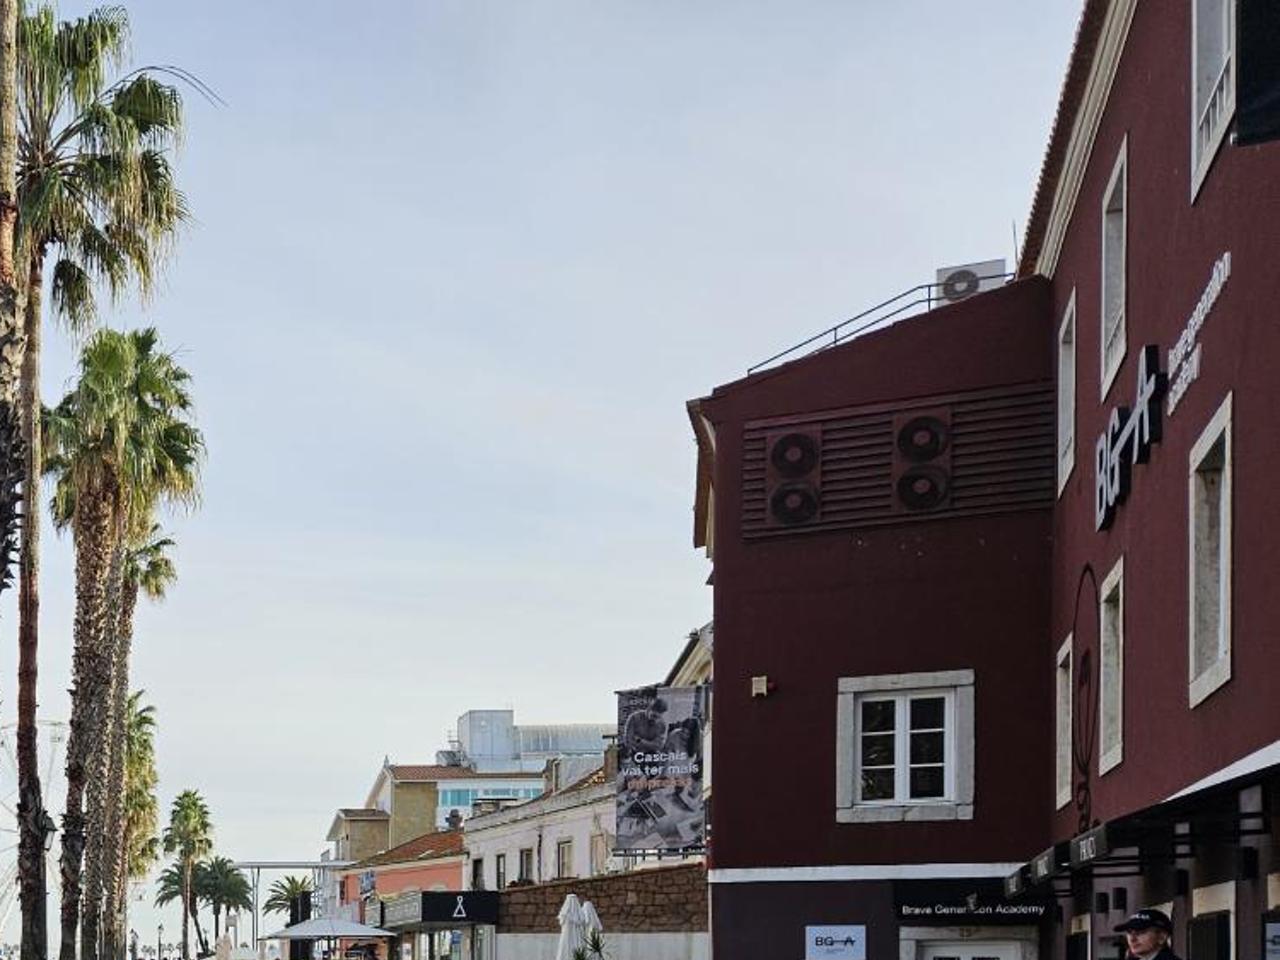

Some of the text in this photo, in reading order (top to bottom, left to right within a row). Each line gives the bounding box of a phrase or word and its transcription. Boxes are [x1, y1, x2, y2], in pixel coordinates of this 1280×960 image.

[634, 751, 686, 763] Cascais
[623, 762, 699, 776] vai ter mais
[902, 904, 1045, 916] Brave Generon Academy
